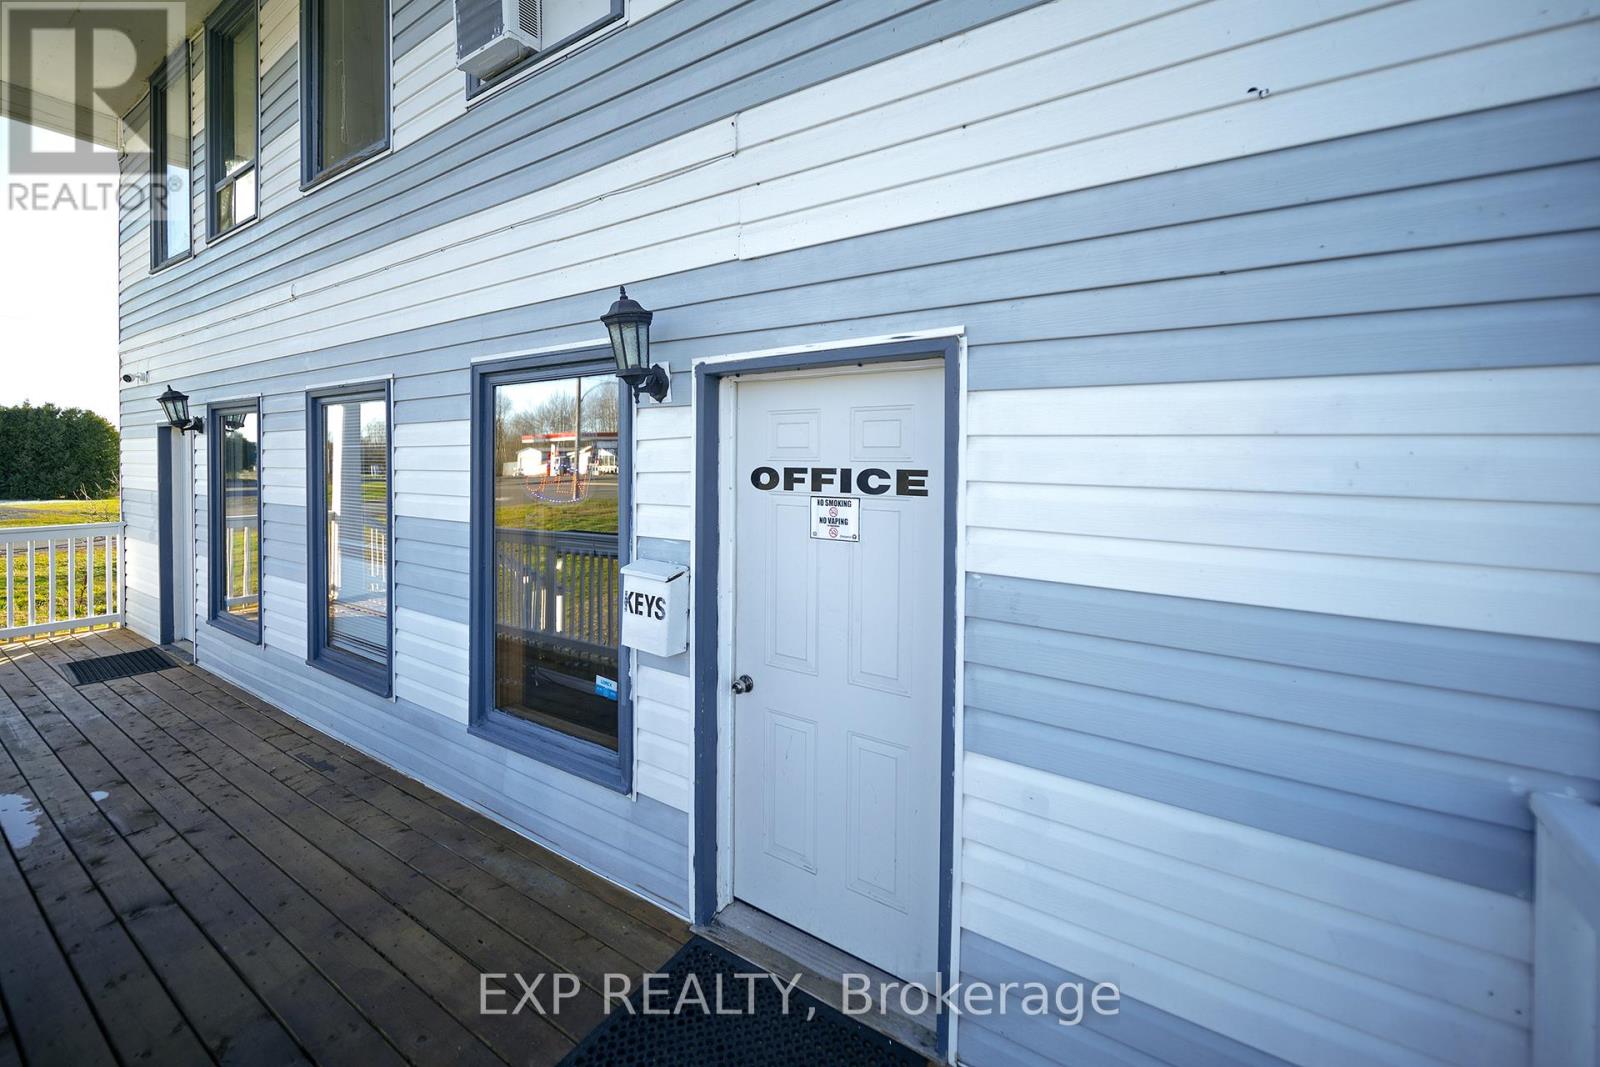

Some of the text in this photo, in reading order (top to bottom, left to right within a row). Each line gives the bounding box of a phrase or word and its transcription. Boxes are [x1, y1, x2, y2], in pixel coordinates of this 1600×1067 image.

[750, 466, 929, 497] OFFICE
[825, 499, 852, 508] SMOKING
[819, 517, 827, 525] NO
[827, 517, 849, 526] VAPING
[624, 590, 667, 621] KEYS
